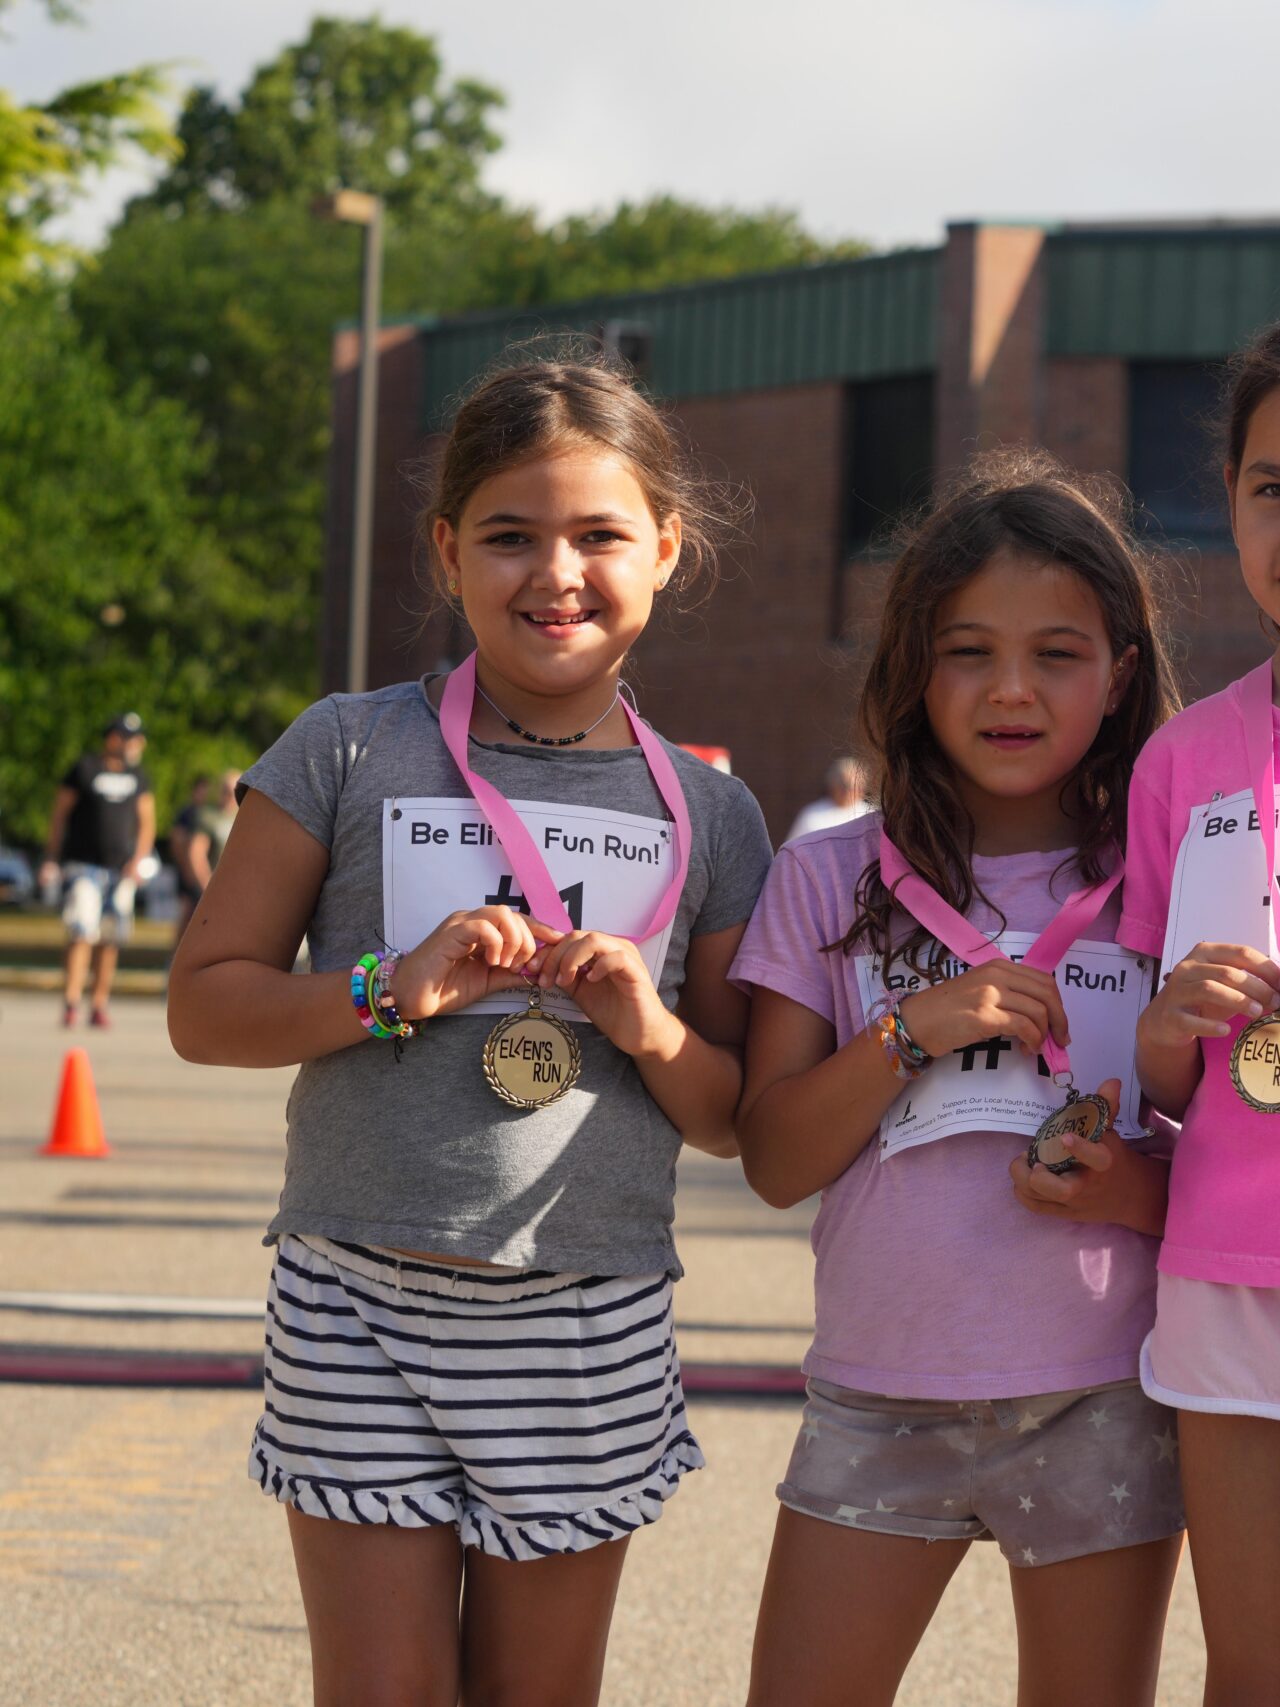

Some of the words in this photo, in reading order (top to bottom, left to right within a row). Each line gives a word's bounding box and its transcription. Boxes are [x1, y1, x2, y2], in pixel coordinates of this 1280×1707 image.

[1204, 816, 1239, 838] Be
[410, 822, 449, 845] Be
[544, 827, 594, 854] Fun
[604, 834, 660, 866] Run!
[1065, 963, 1127, 993] Run!
[533, 1062, 562, 1084] RUN
[983, 1096, 1003, 1104] Local
[1004, 1097, 1024, 1107] Youth
[990, 1106, 1017, 1115] Member
